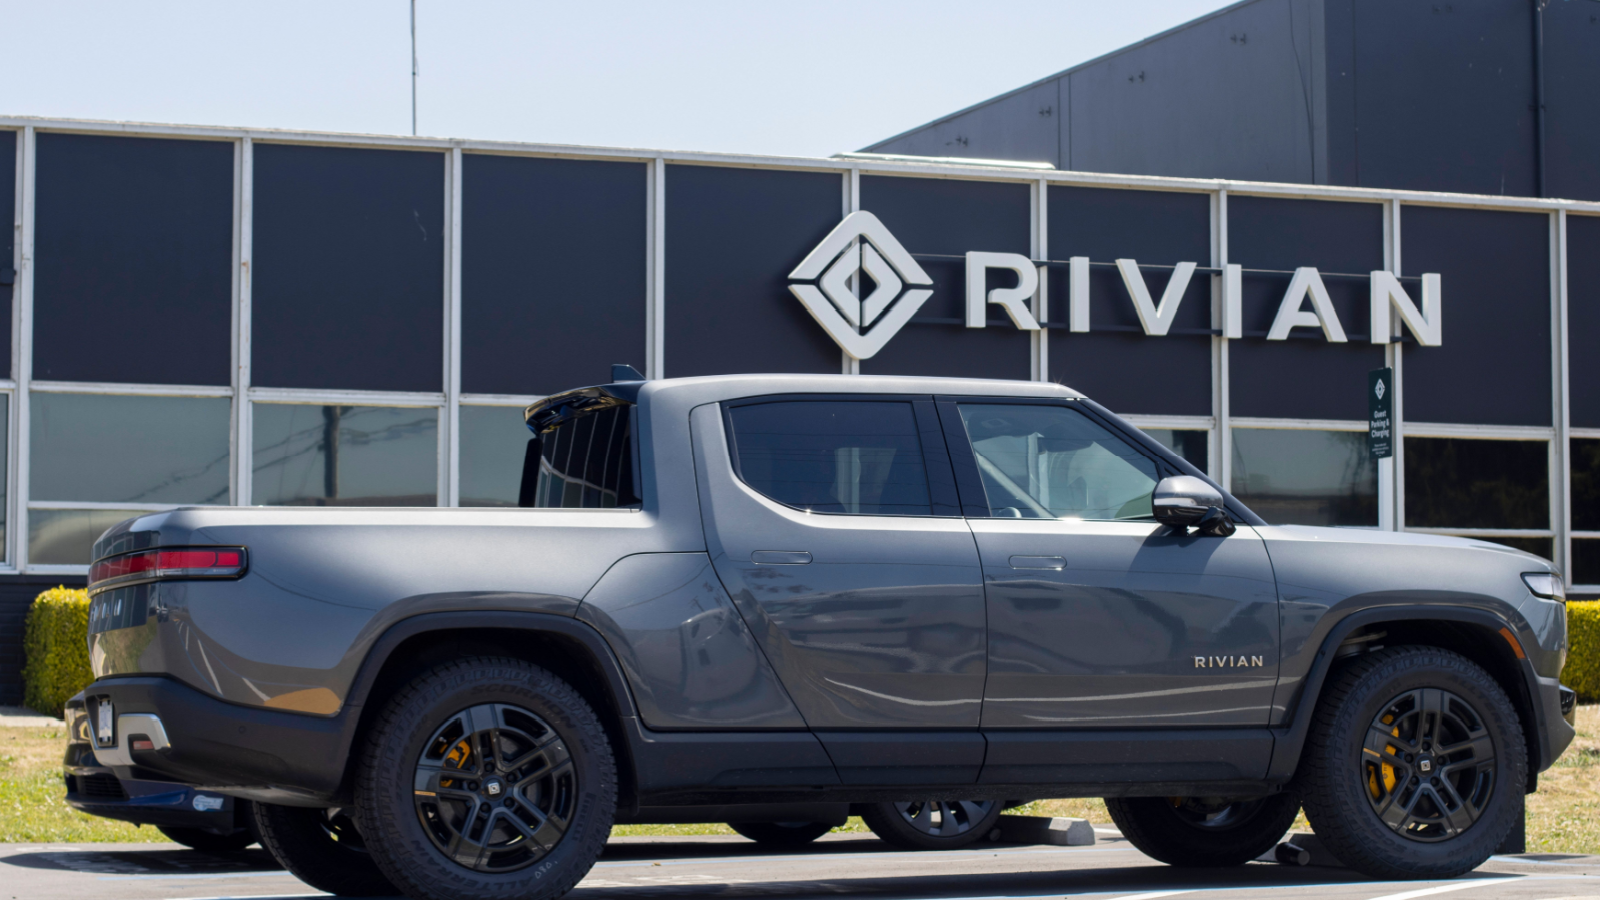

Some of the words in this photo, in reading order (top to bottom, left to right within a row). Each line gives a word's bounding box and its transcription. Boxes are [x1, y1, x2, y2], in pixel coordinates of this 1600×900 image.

[966, 251, 1442, 346] RIVIAN
[1374, 410, 1386, 418] Guest
[1371, 420, 1386, 430] Parking
[1386, 418, 1390, 426] &
[1371, 429, 1389, 438] Charging
[1194, 655, 1263, 668] RIVIAN
[470, 683, 577, 728] SCORPION
